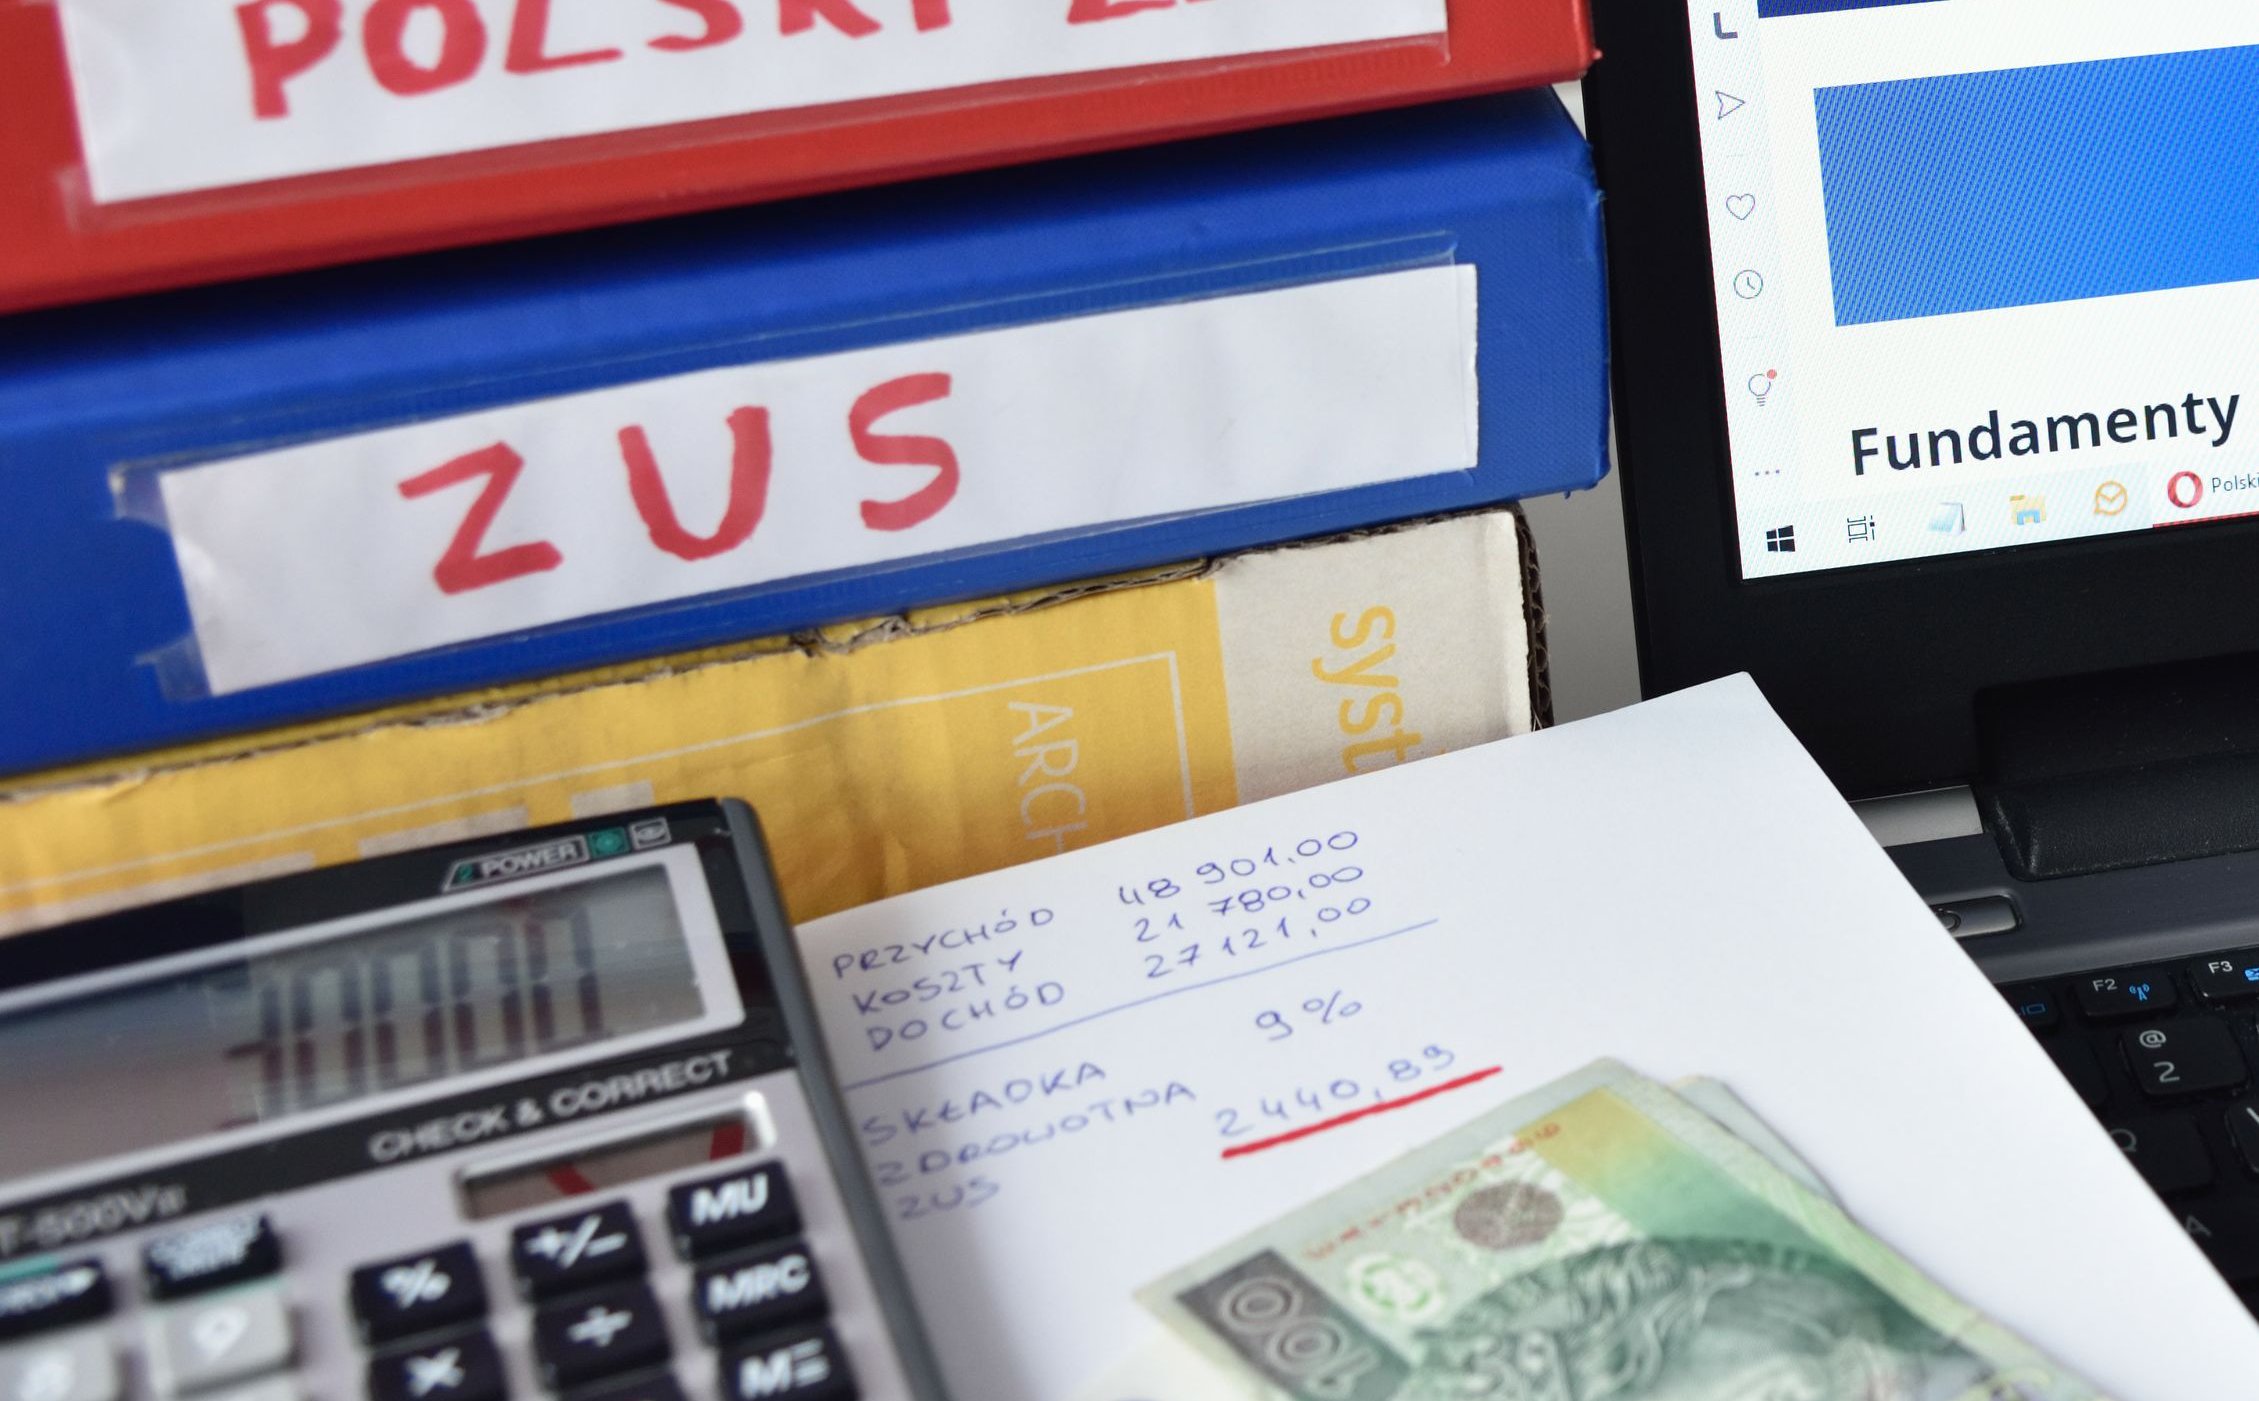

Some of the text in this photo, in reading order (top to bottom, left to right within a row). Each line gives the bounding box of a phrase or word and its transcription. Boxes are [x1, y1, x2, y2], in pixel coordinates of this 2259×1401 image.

[1851, 393, 2240, 476] Fundamenty
[398, 372, 959, 595] ZUS
[481, 843, 578, 878] POWER
[832, 908, 1055, 979] PRZYCHÓD
[1119, 877, 1181, 905] 48
[853, 949, 1023, 1015] KOSZTY
[1134, 912, 1183, 942] 21
[2092, 978, 2118, 992] F2
[2208, 960, 2233, 975] F3
[867, 981, 1065, 1051] DOCHÓD
[1145, 943, 1200, 978] 27
[2139, 1029, 2166, 1049] @
[2153, 1061, 2181, 1083] 2
[368, 1050, 733, 1162] CHECK & CORRECT
[690, 1174, 769, 1226] MU
[899, 1176, 1000, 1221] ZUS
[706, 1253, 811, 1313] MRC
